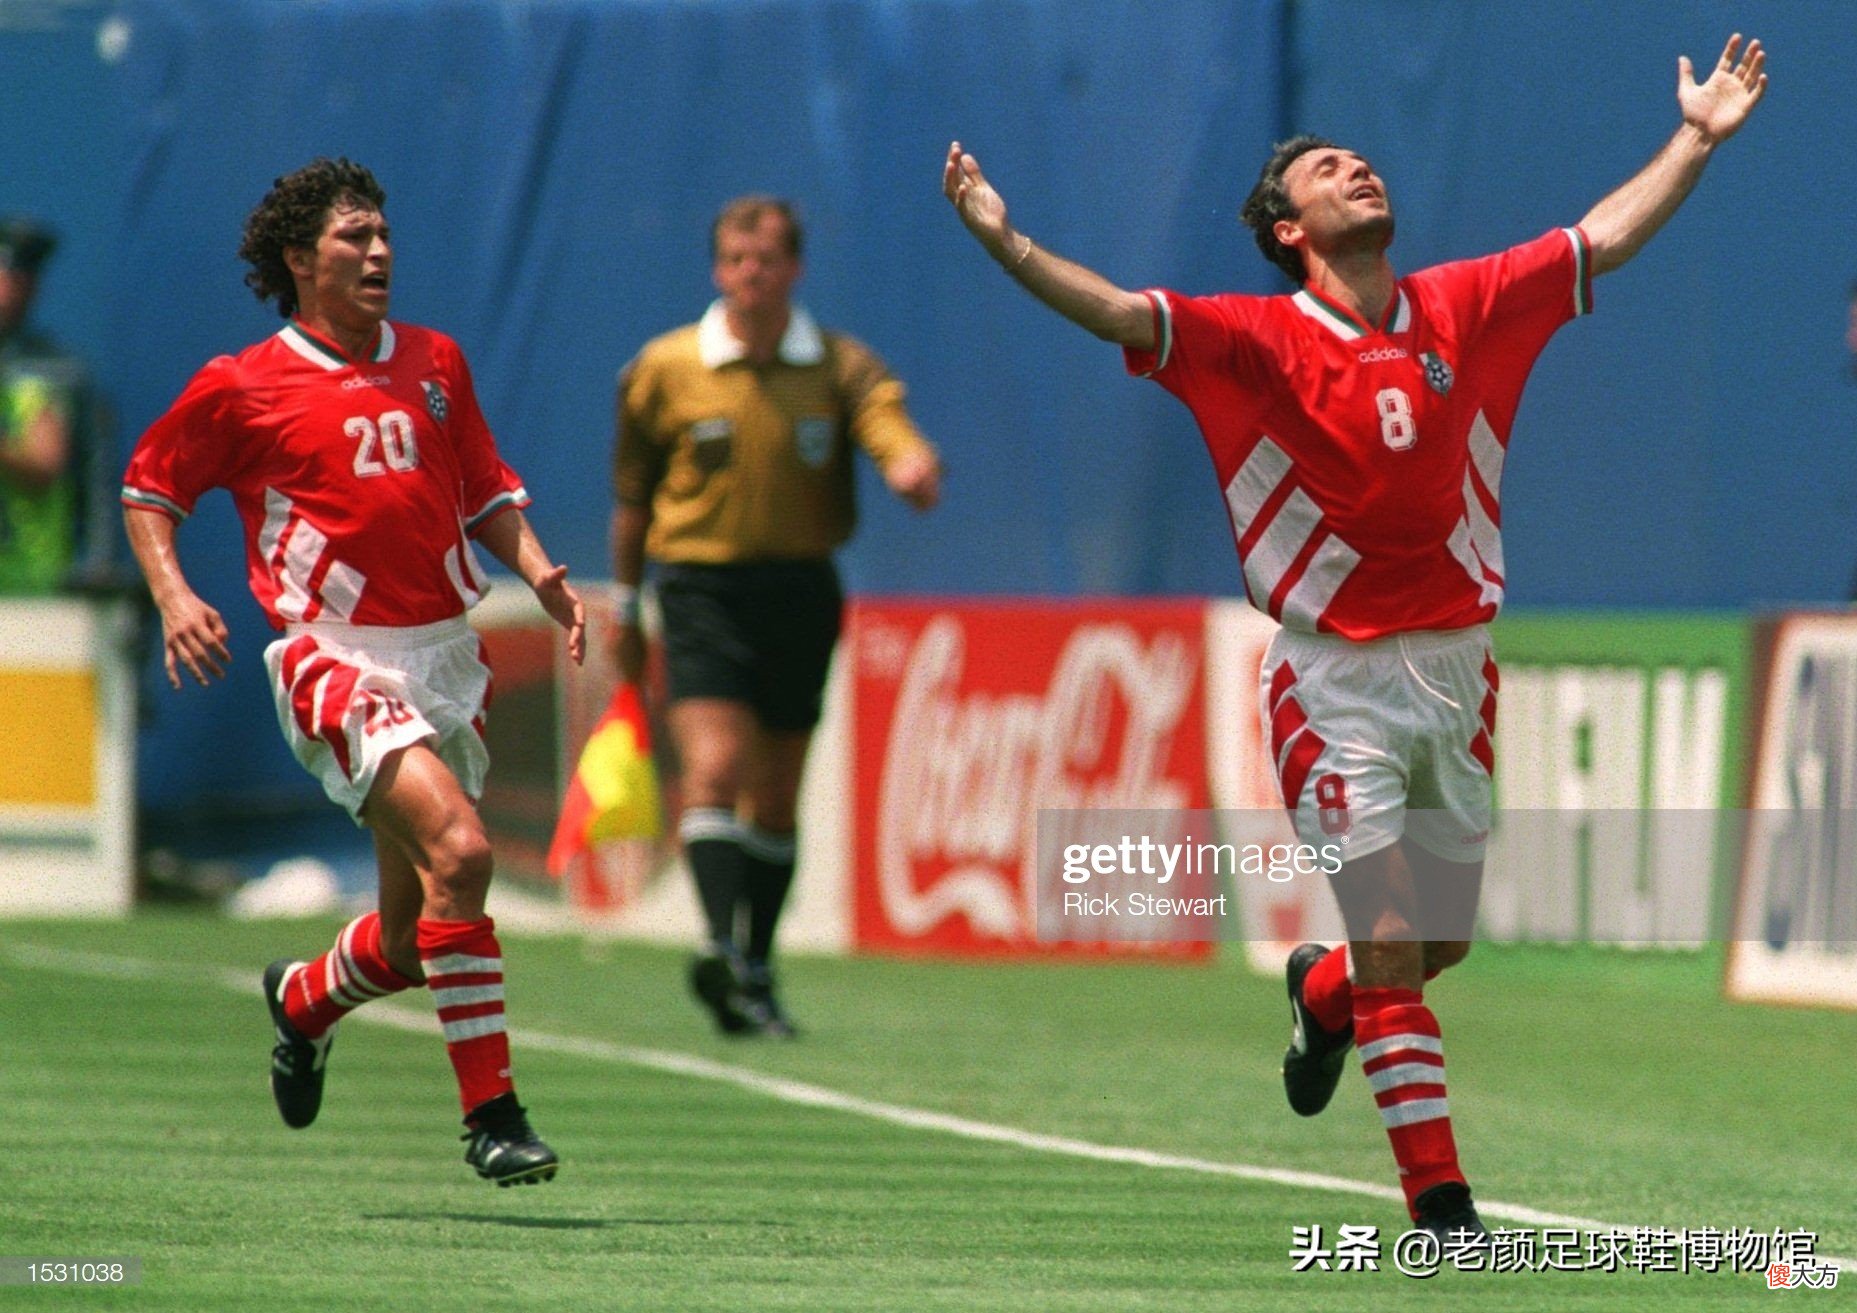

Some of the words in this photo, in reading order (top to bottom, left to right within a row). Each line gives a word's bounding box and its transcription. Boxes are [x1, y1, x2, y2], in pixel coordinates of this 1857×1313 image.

[1359, 347, 1408, 363] adidas
[343, 409, 419, 478] 20
[1376, 387, 1418, 452] 8
[1315, 773, 1352, 838] 8
